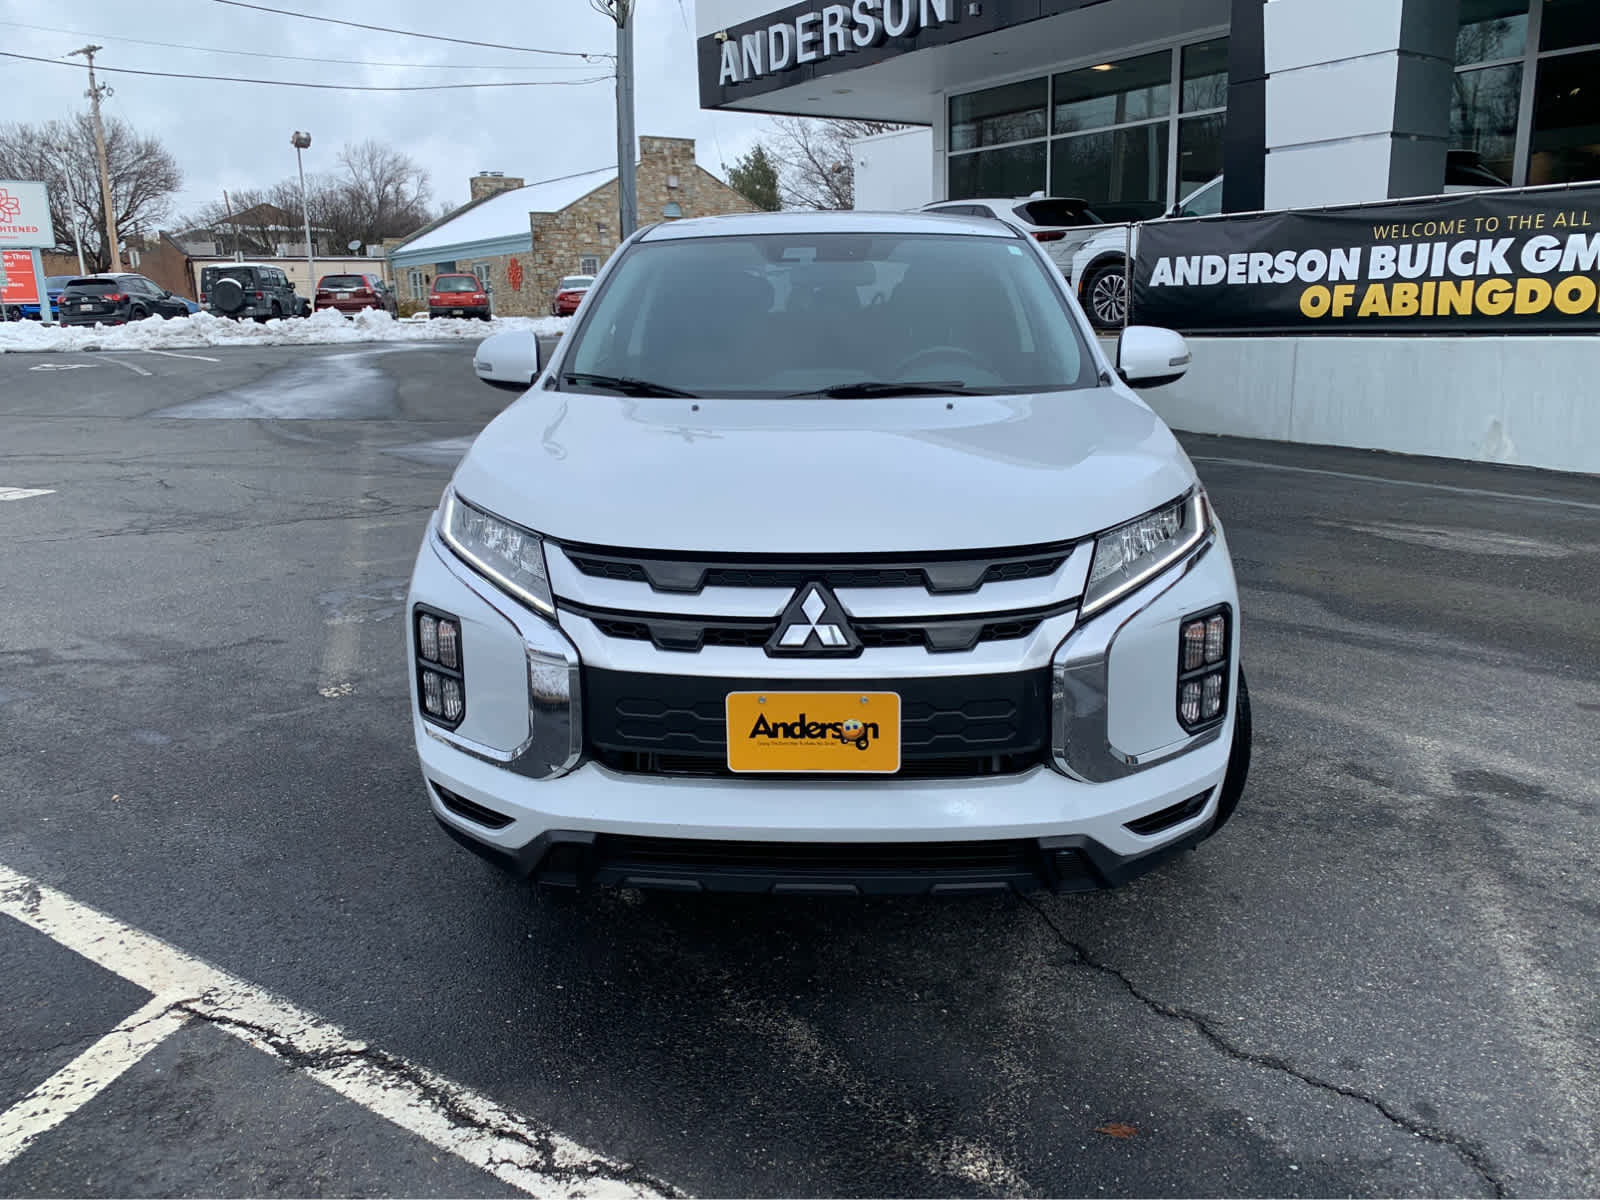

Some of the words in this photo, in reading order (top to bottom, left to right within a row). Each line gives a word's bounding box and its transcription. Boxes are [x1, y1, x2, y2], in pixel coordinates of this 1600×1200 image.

[1373, 218, 1467, 240] WELCOME
[1474, 216, 1500, 233] TO
[1507, 213, 1546, 231] THE
[1552, 210, 1592, 228] ALL
[1149, 248, 1362, 287] ANDERSON
[1368, 237, 1516, 280] BUICK
[1299, 284, 1356, 319] OF
[1357, 275, 1600, 317] ABINGDO
[749, 713, 879, 742] Anderson
